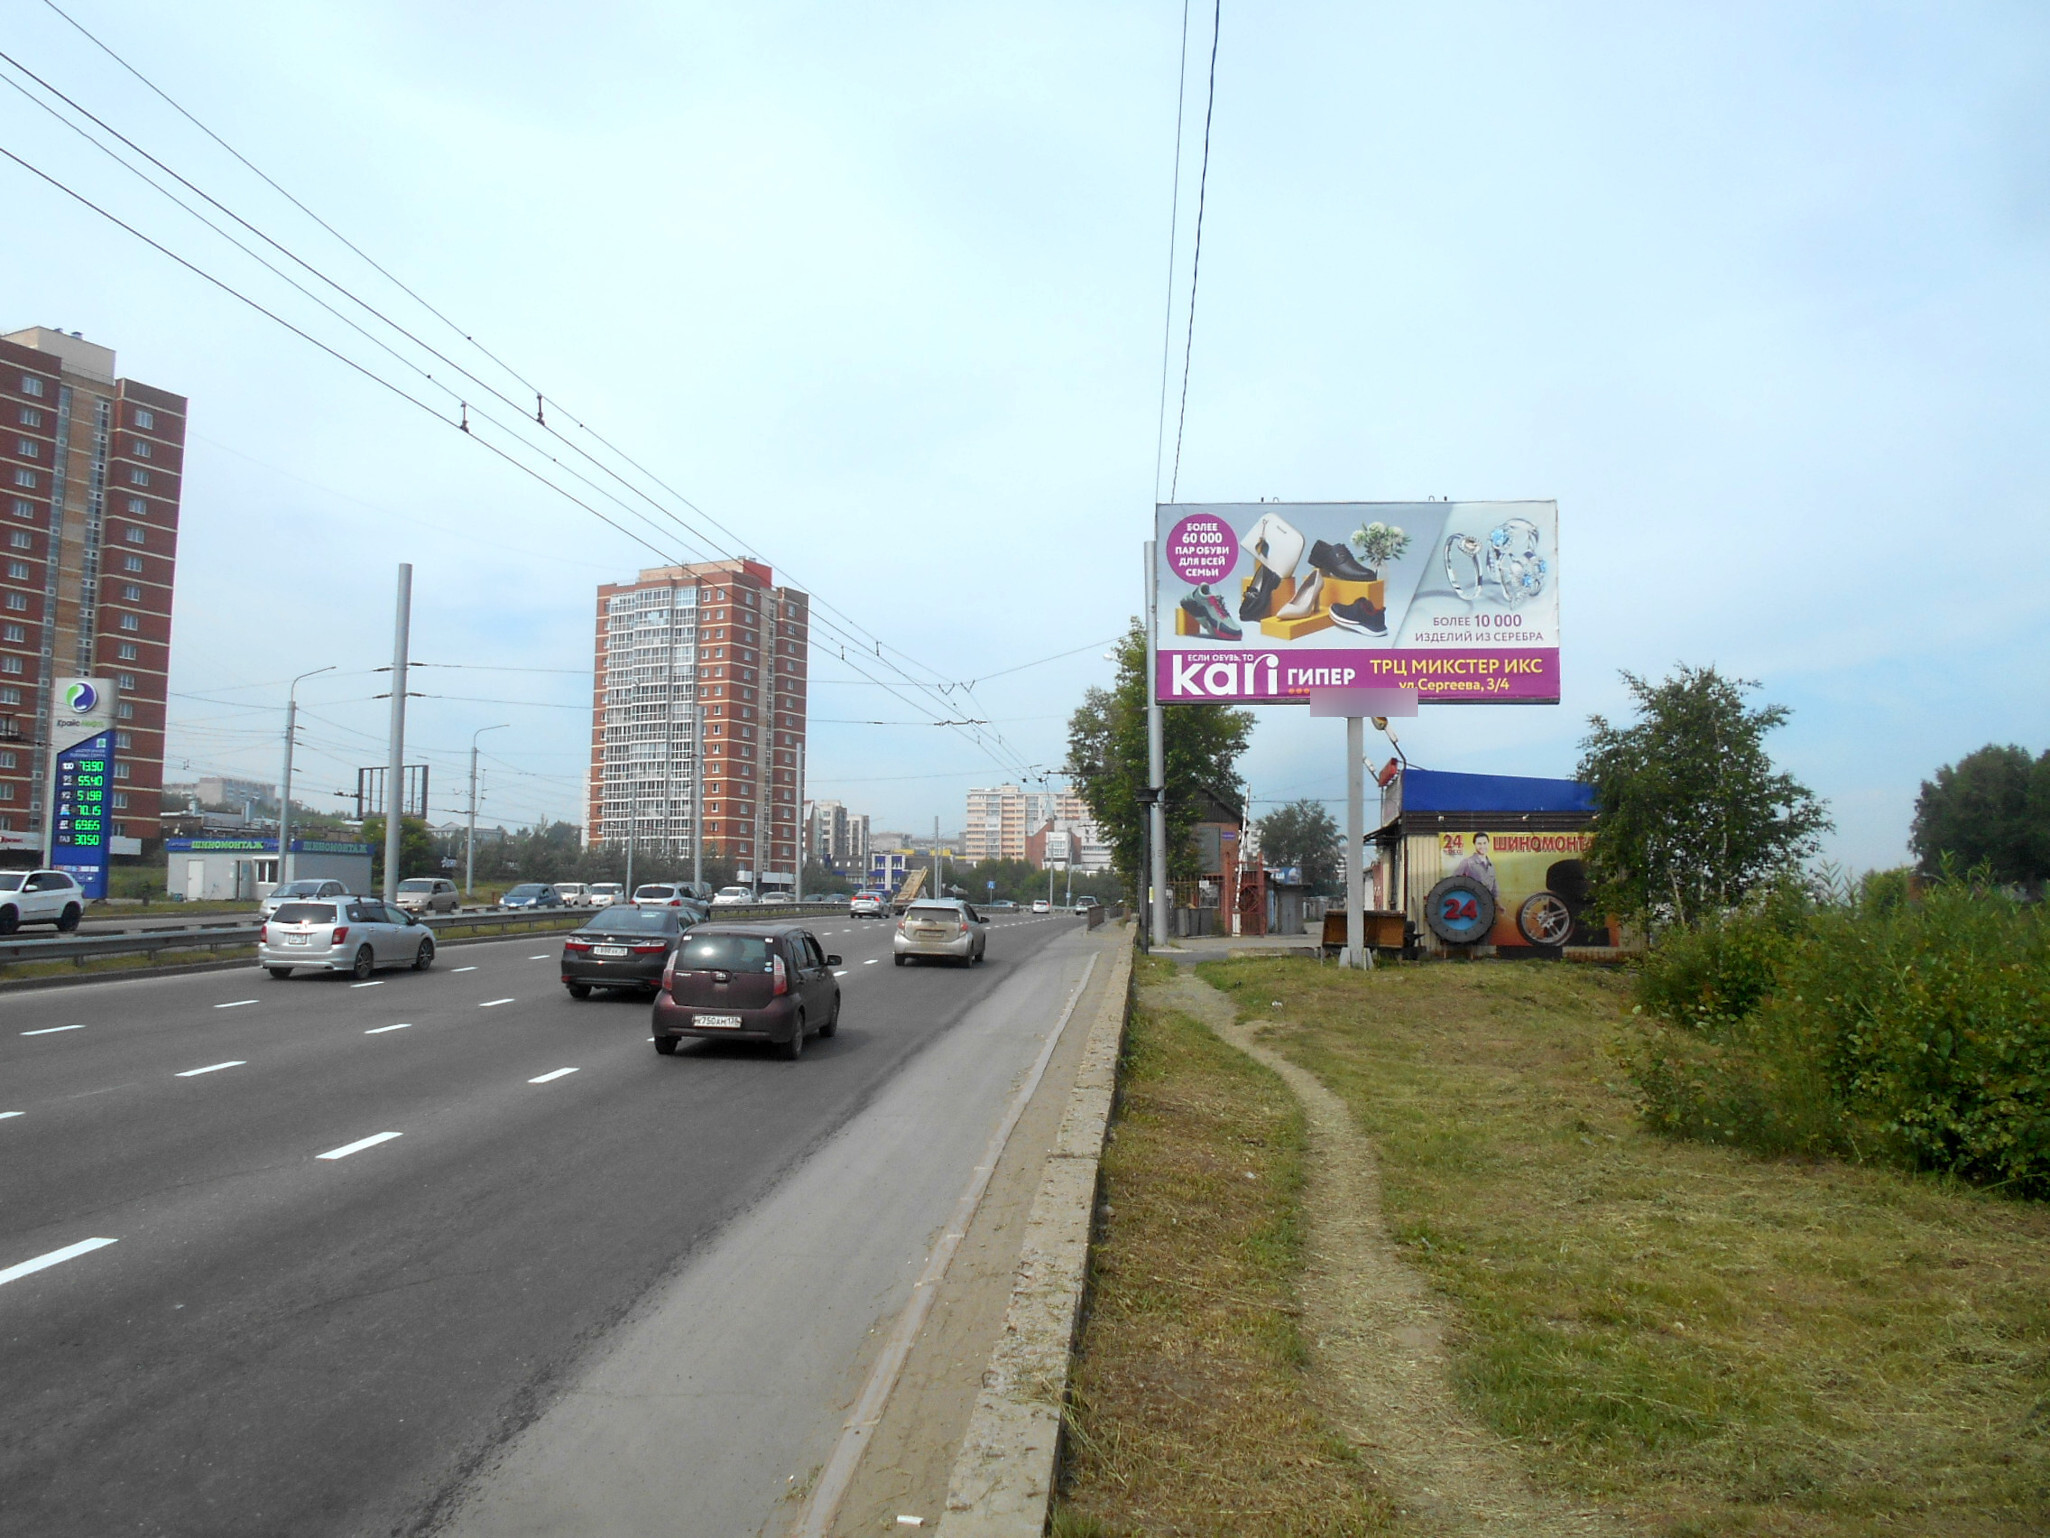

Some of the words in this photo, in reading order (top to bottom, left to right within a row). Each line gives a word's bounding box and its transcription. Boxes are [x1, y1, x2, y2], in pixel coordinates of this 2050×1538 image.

[1186, 523, 1218, 531] БОЛЕЕ
[1182, 532, 1198, 544] 60
[1200, 532, 1223, 544] 000
[1175, 546, 1195, 554] ПАР
[1196, 546, 1229, 554] ОБУВИ
[1179, 557, 1199, 566] ДЛЯ
[1201, 556, 1225, 566] ВСЕЙ
[1186, 568, 1219, 576] СЕМЬИ
[1433, 617, 1471, 626] БОЛЕЕ
[1475, 614, 1490, 627] 10
[1494, 614, 1522, 627] 000
[1415, 631, 1473, 643] ИЗДЕЛИЙ
[1475, 632, 1491, 641] ИЗ
[1493, 632, 1544, 641] СЕРЕБРА
[1188, 654, 1210, 662] ЕСЛИ
[1242, 654, 1254, 662] ТО
[1370, 659, 1408, 676] ТРЦ
[1411, 659, 1500, 674] МИКСТЕР
[1504, 658, 1543, 674] ИКС
[1172, 653, 1279, 695] kari
[1287, 668, 1356, 686] ГИПЕР
[1486, 677, 1510, 693] 3/4
[191, 840, 264, 850] ШИНОМОНТАЖ
[1444, 835, 1464, 848] 24
[1444, 899, 1478, 920] 24
